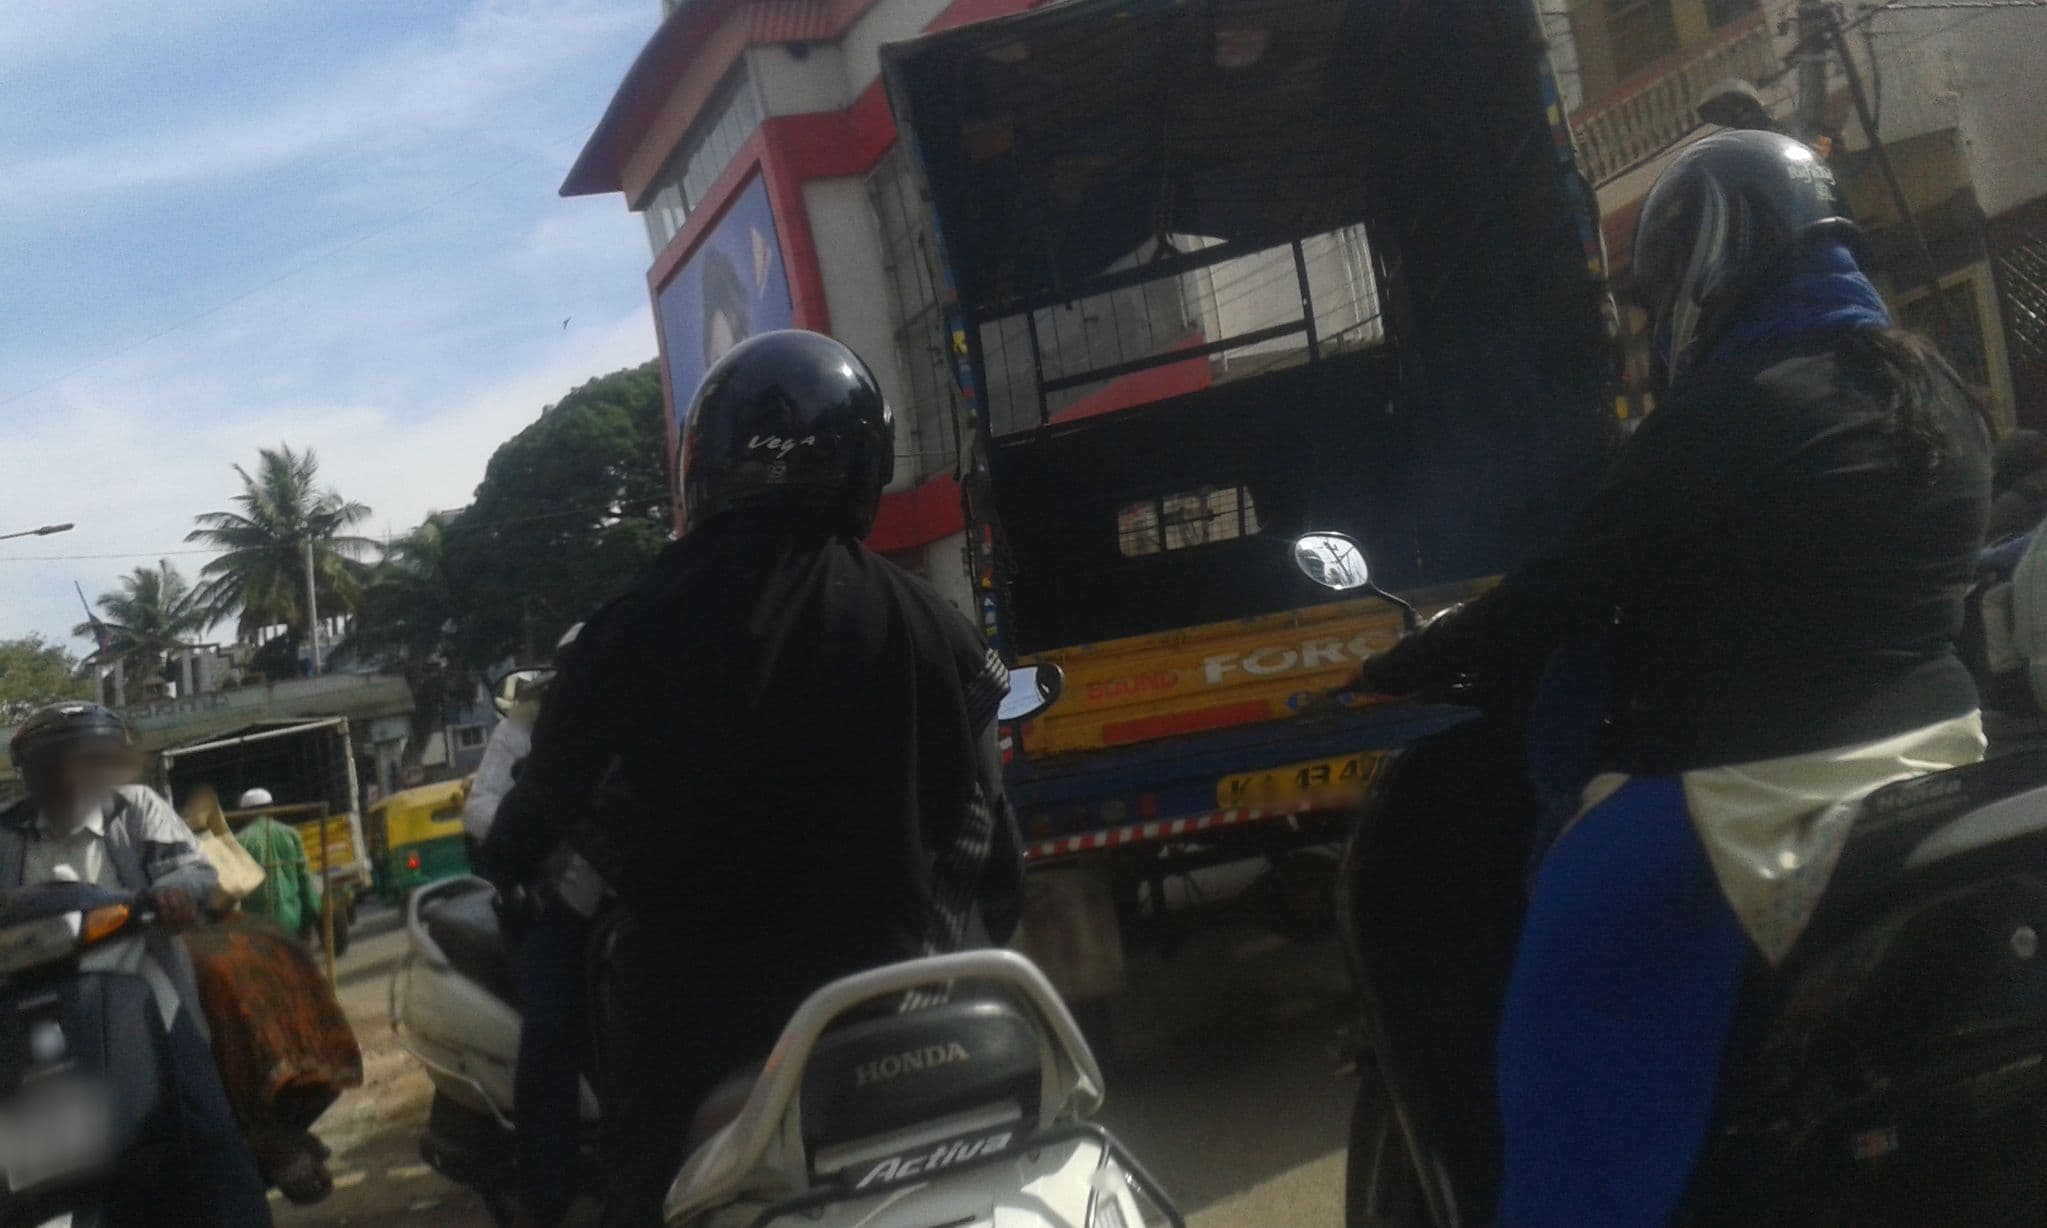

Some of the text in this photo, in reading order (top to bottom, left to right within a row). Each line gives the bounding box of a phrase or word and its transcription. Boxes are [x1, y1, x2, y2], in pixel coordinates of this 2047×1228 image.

[1204, 630, 1402, 685] FORC
[855, 1041, 970, 1086] HONDA
[856, 1132, 1013, 1189] Activa
